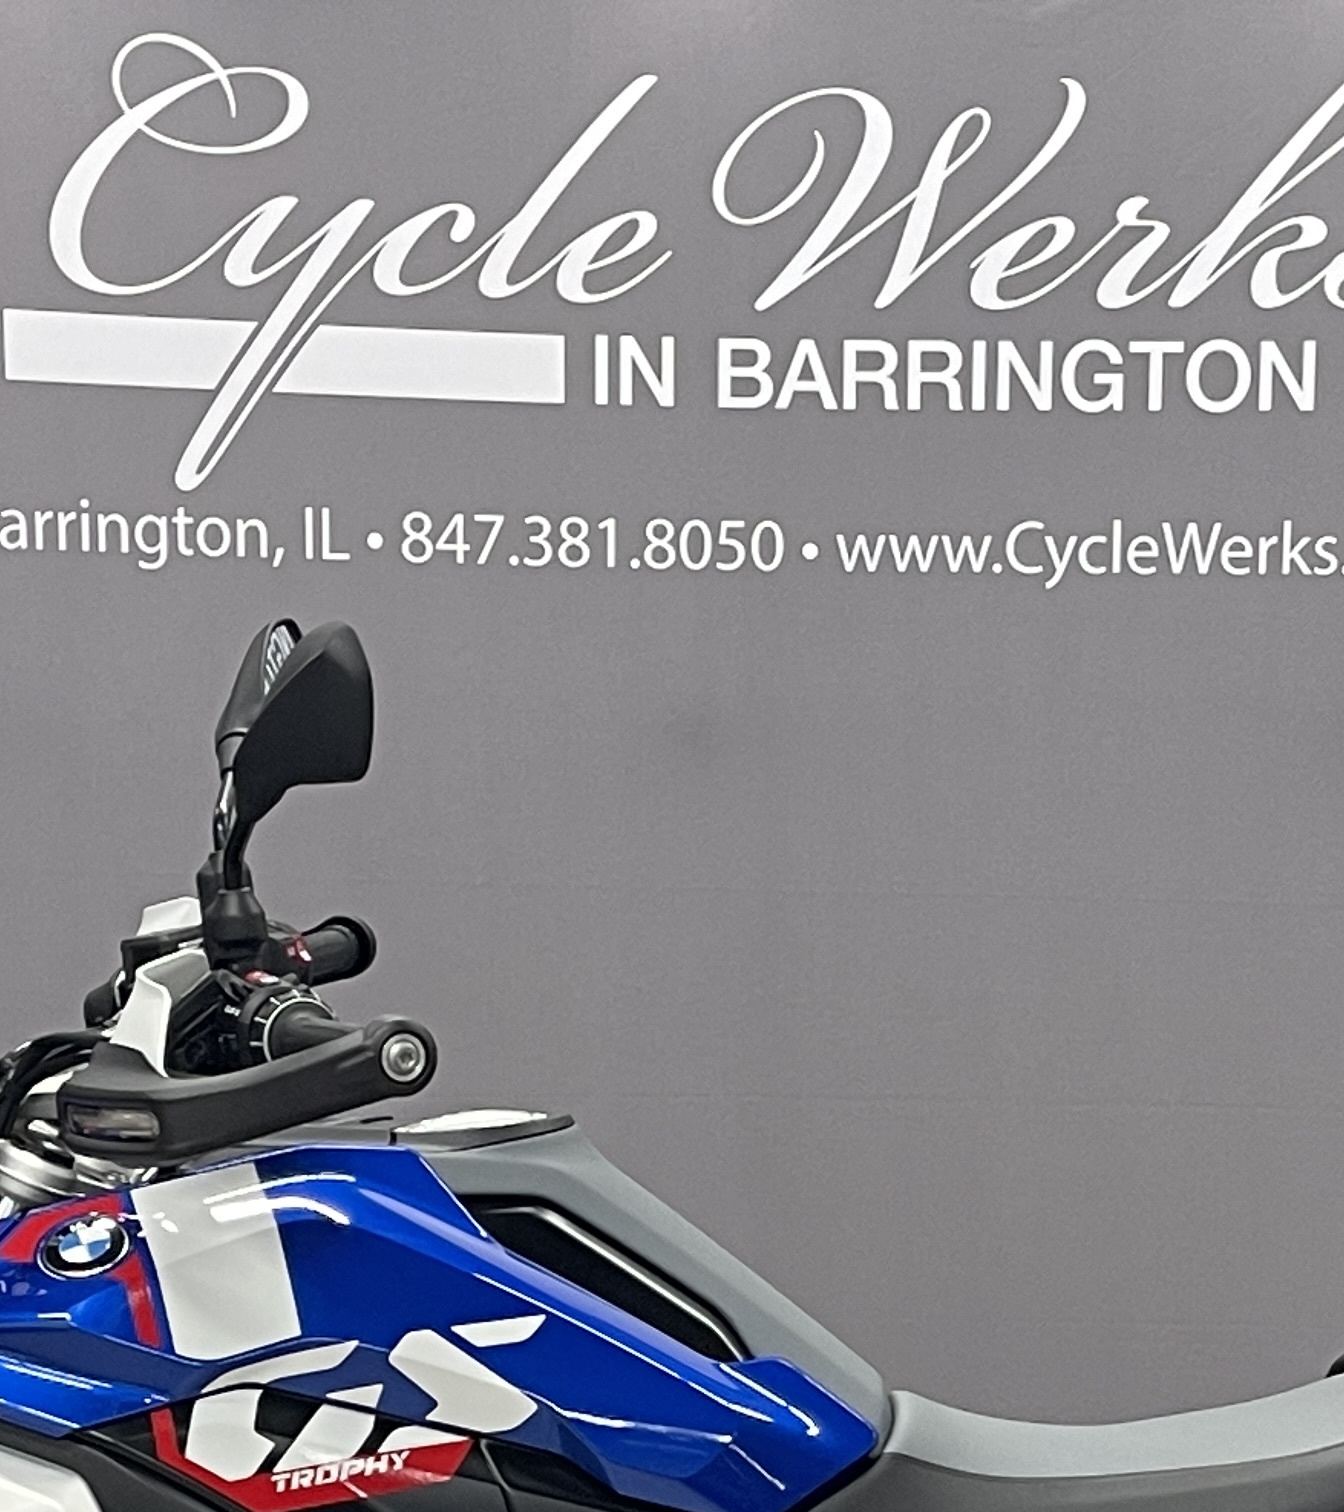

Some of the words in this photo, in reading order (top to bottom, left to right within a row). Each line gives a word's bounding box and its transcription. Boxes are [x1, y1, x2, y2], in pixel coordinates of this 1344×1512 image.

[50, 31, 674, 492] Cycle
[595, 334, 674, 406] IN
[718, 338, 1316, 412] BARRINGTON
[305, 507, 350, 560] IL
[402, 511, 784, 571] 847.381.8050
[185, 1313, 546, 1482] GS
[271, 1450, 411, 1493] TROPHY
